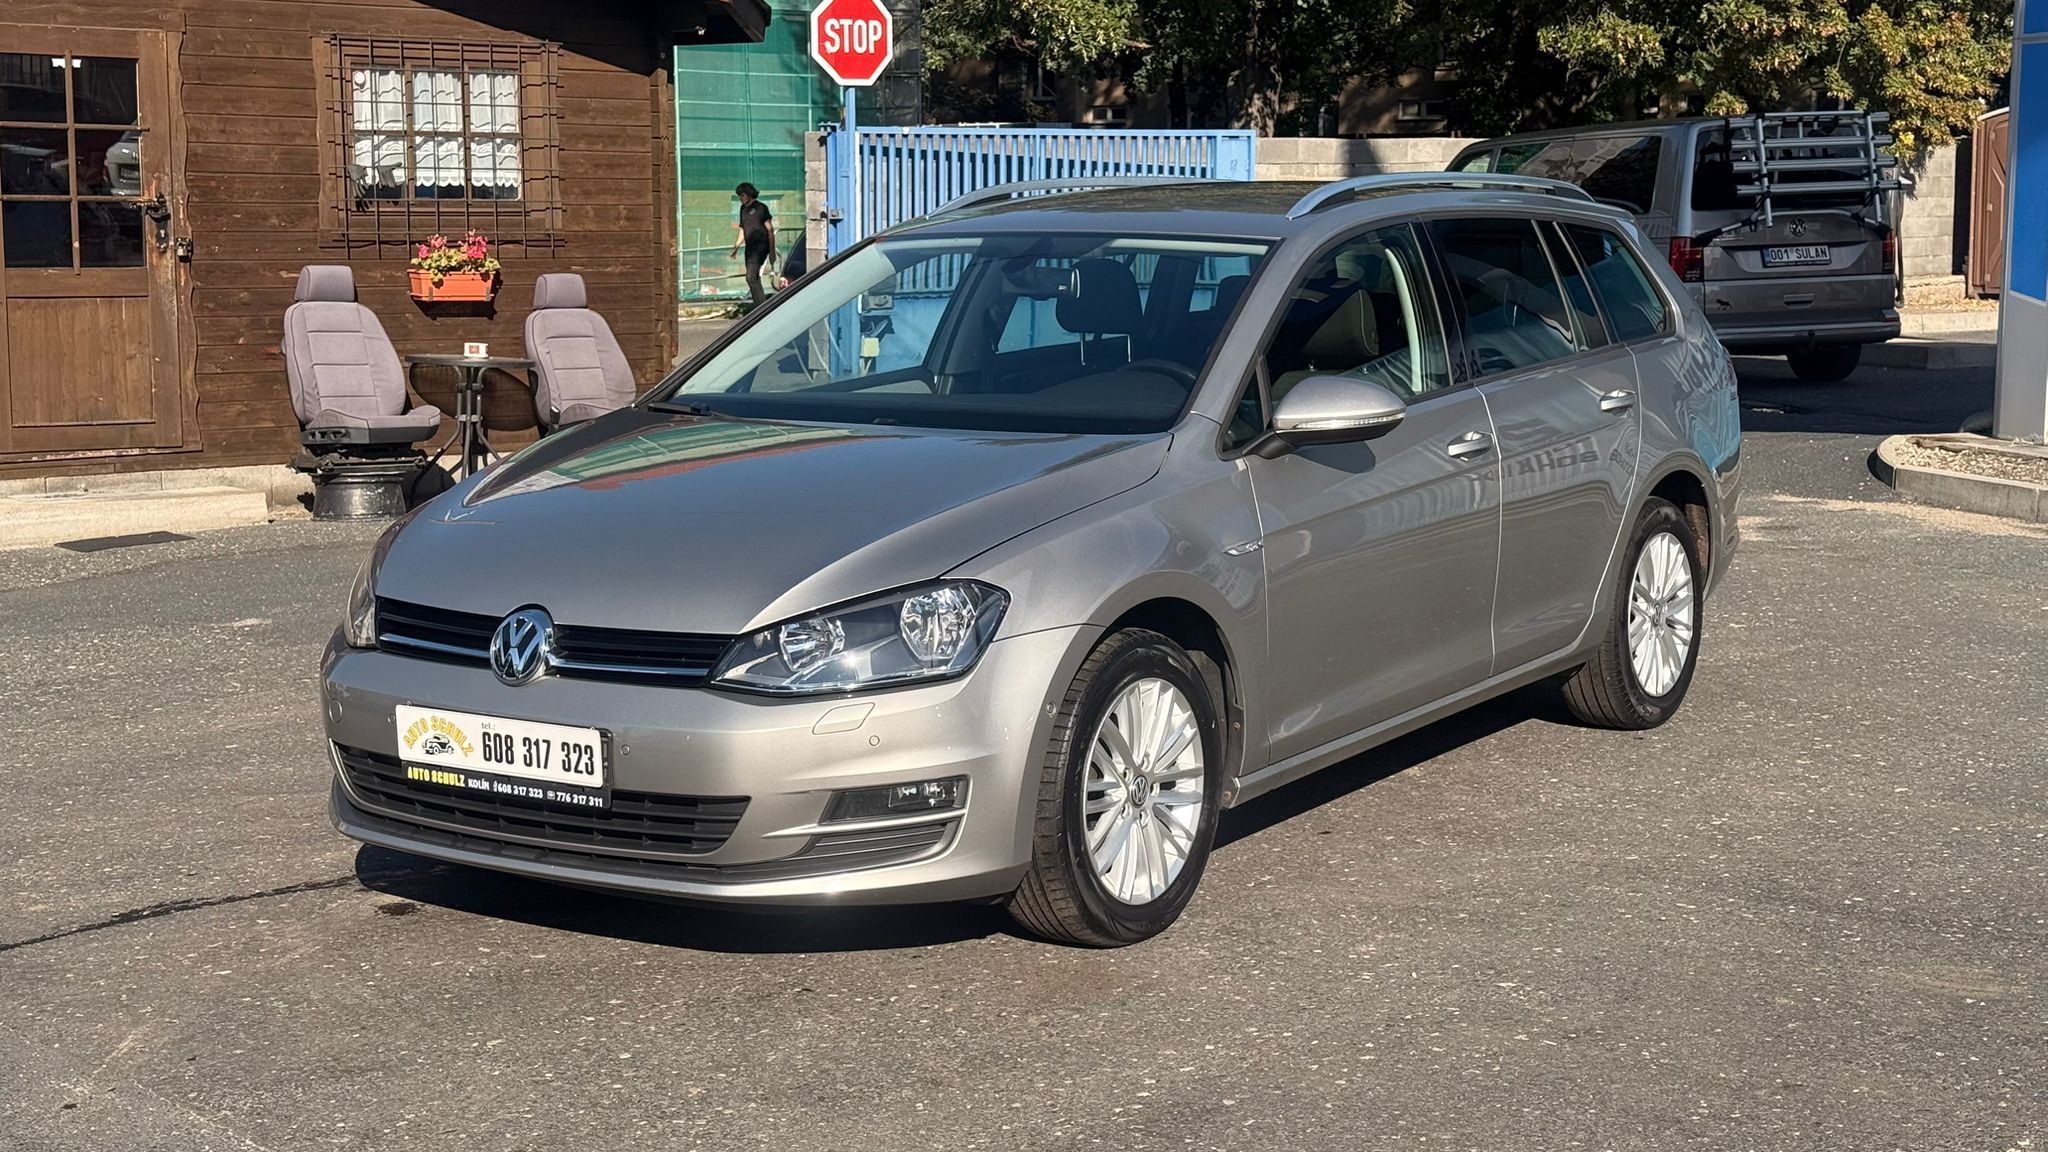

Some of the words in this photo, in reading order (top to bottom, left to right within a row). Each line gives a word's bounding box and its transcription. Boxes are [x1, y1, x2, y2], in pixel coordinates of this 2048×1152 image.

[824, 18, 883, 54] STOP
[1770, 248, 1790, 261] 001
[1795, 246, 1828, 260] SULAN
[403, 718, 429, 750] AUTO
[430, 715, 474, 757] SCHULZ
[482, 731, 515, 765] 608
[522, 737, 552, 770] 317
[561, 741, 595, 776] 323
[407, 766, 431, 782] AUTO
[431, 769, 466, 788] SCHULZ
[467, 778, 490, 791] KOLÍN
[497, 783, 512, 794] 608
[513, 785, 527, 796] 317
[528, 787, 544, 799] 323
[556, 791, 571, 803] 776
[572, 794, 587, 805] 317
[588, 796, 603, 808] 311
